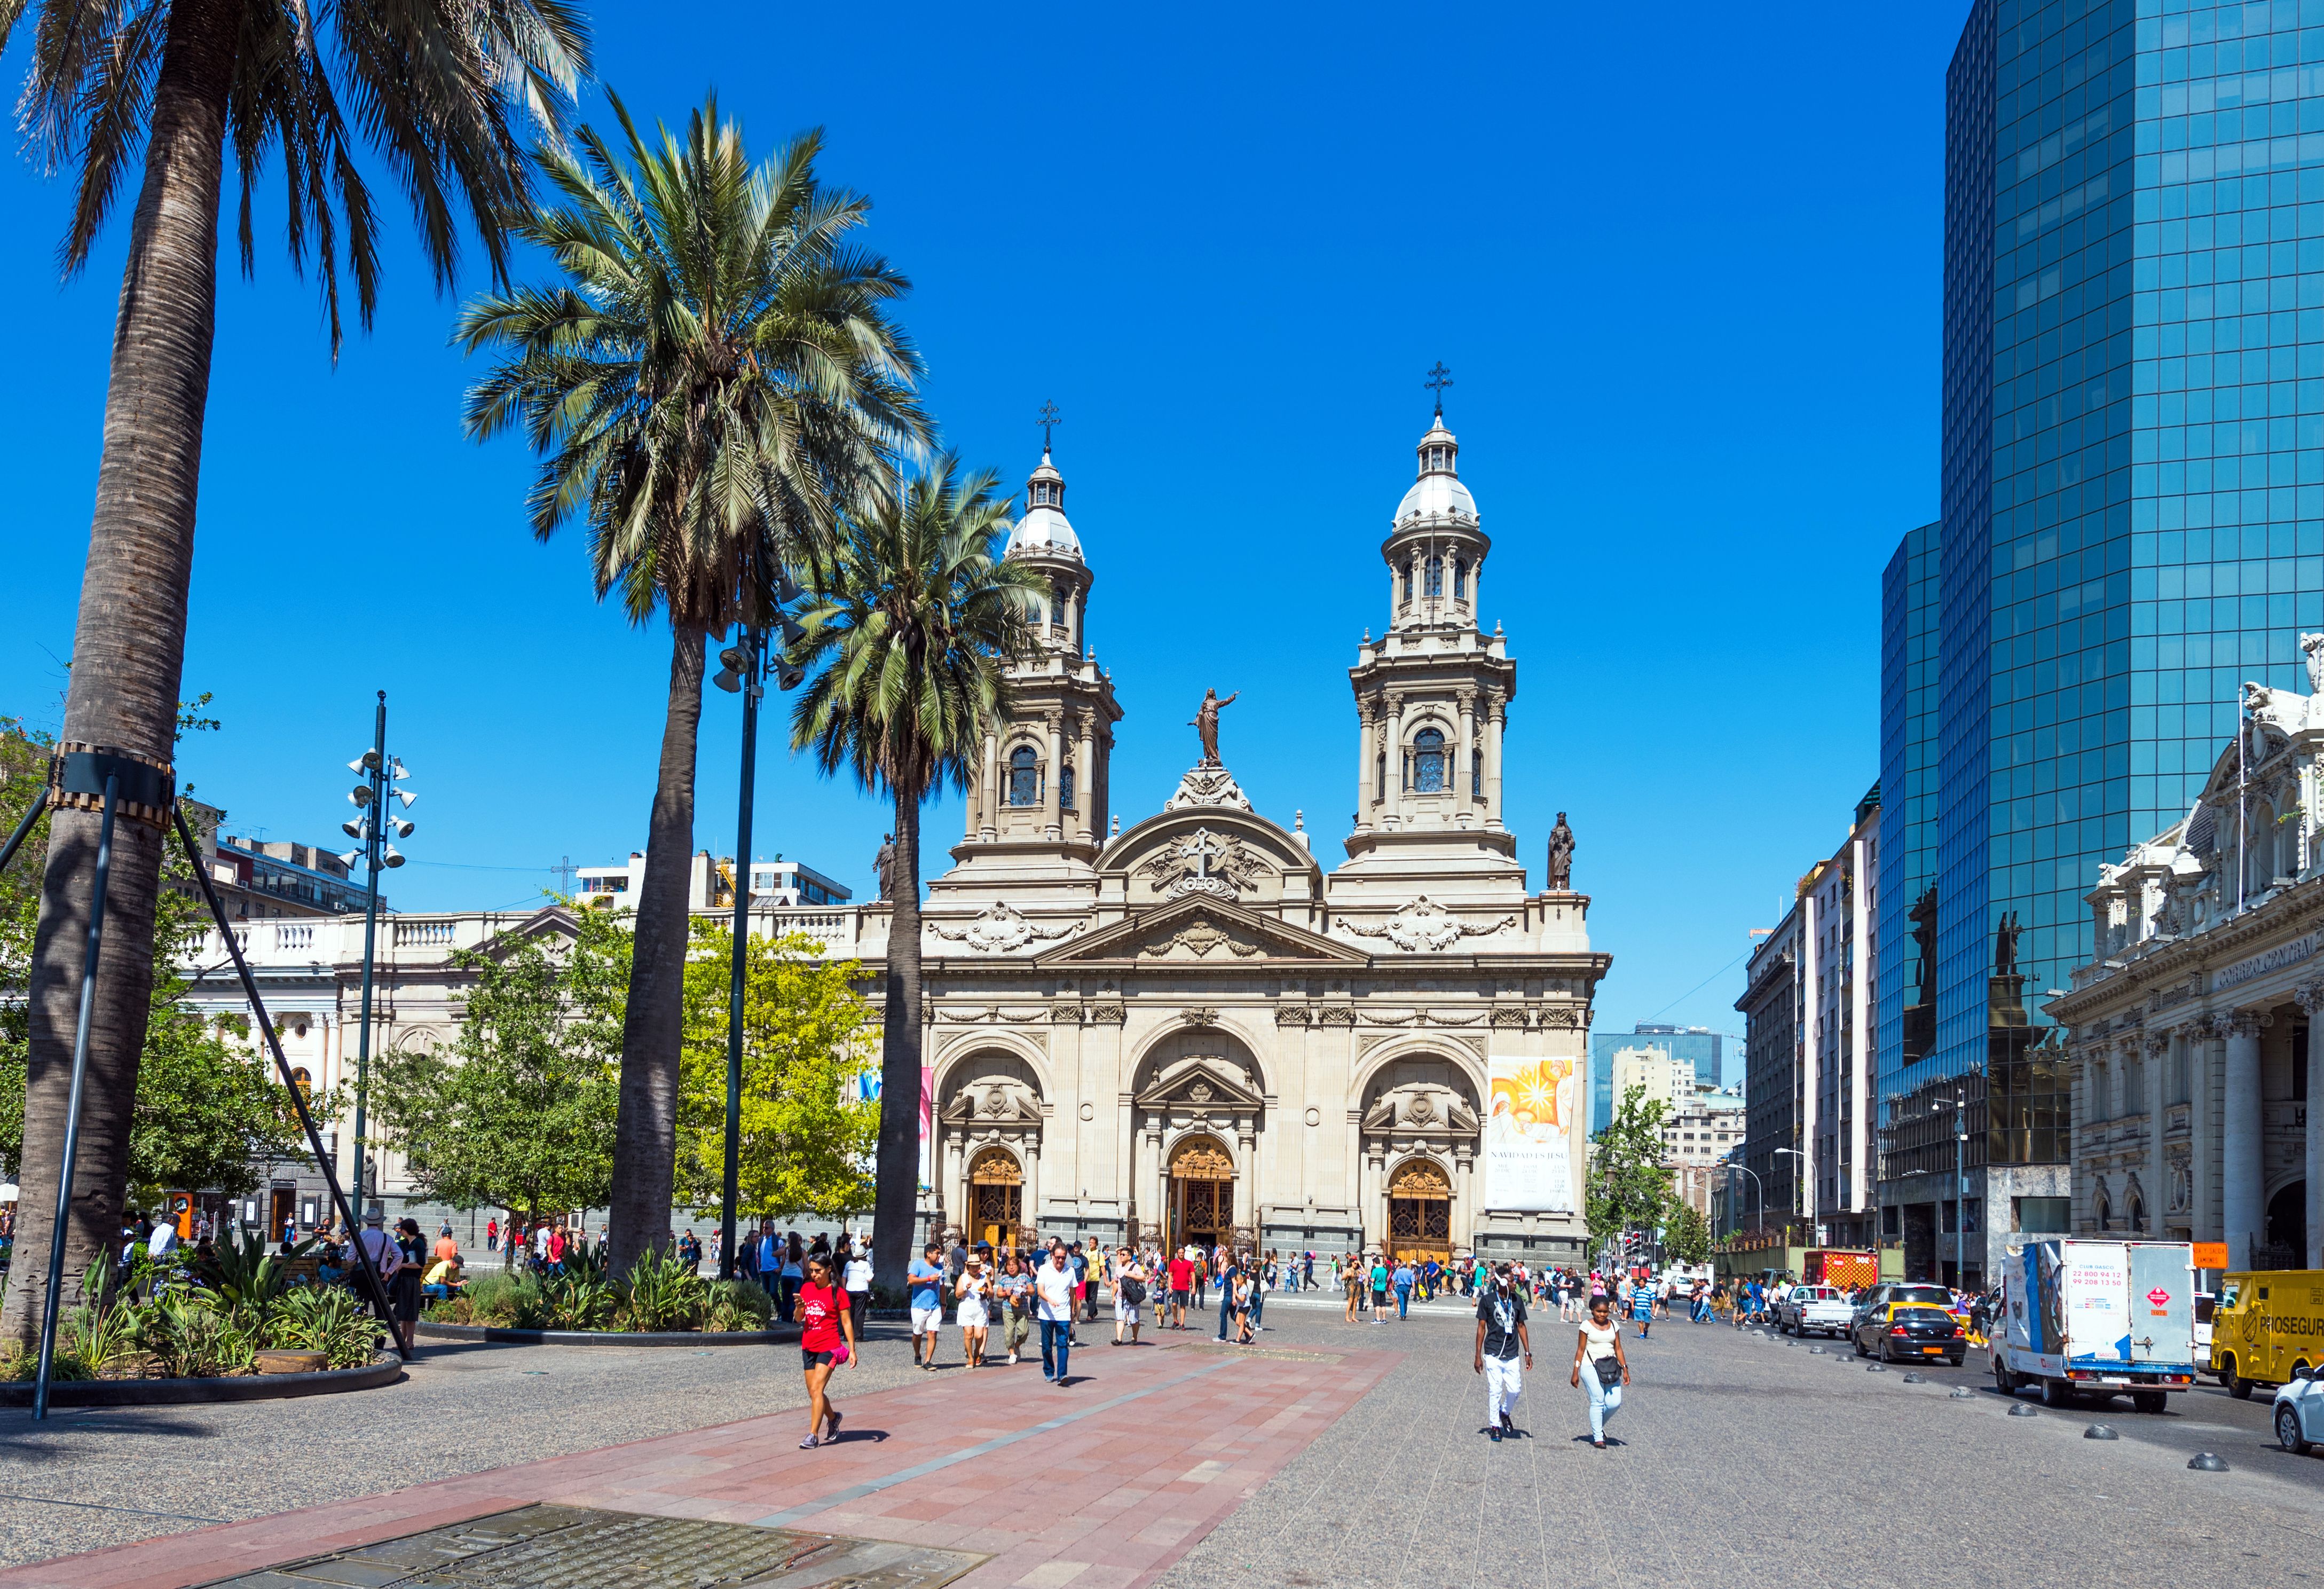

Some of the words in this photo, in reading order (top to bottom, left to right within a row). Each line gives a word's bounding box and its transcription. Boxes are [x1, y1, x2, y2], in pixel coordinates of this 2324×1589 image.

[2219, 958, 2260, 988] CORREO
[2264, 936, 2314, 972] CENTRAL
[2259, 1316, 2324, 1336] PROSEGUR
